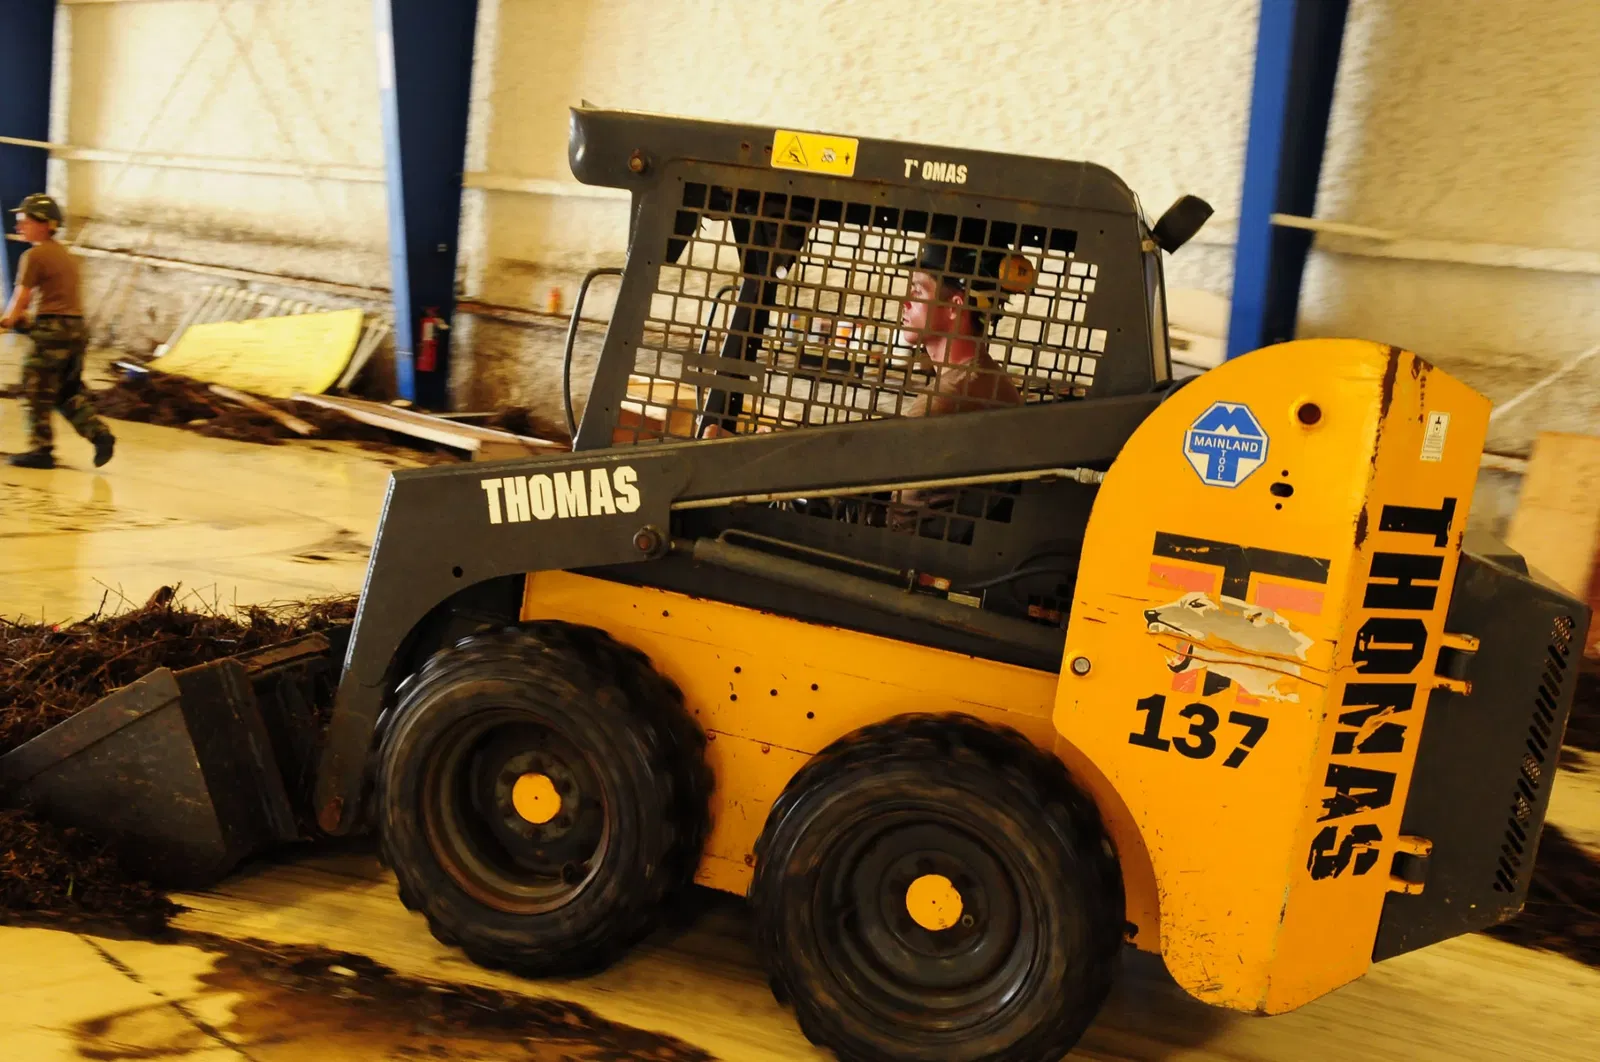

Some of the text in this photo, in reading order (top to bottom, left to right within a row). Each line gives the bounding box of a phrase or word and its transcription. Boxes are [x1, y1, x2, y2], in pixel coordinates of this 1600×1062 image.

[904, 158, 968, 184] TOMAS
[1193, 435, 1259, 453] MAINLAND
[1217, 449, 1227, 480] TOOL
[480, 465, 641, 525] THOMAS
[1307, 497, 1458, 881] THOMAS
[1128, 693, 1269, 769] 137
